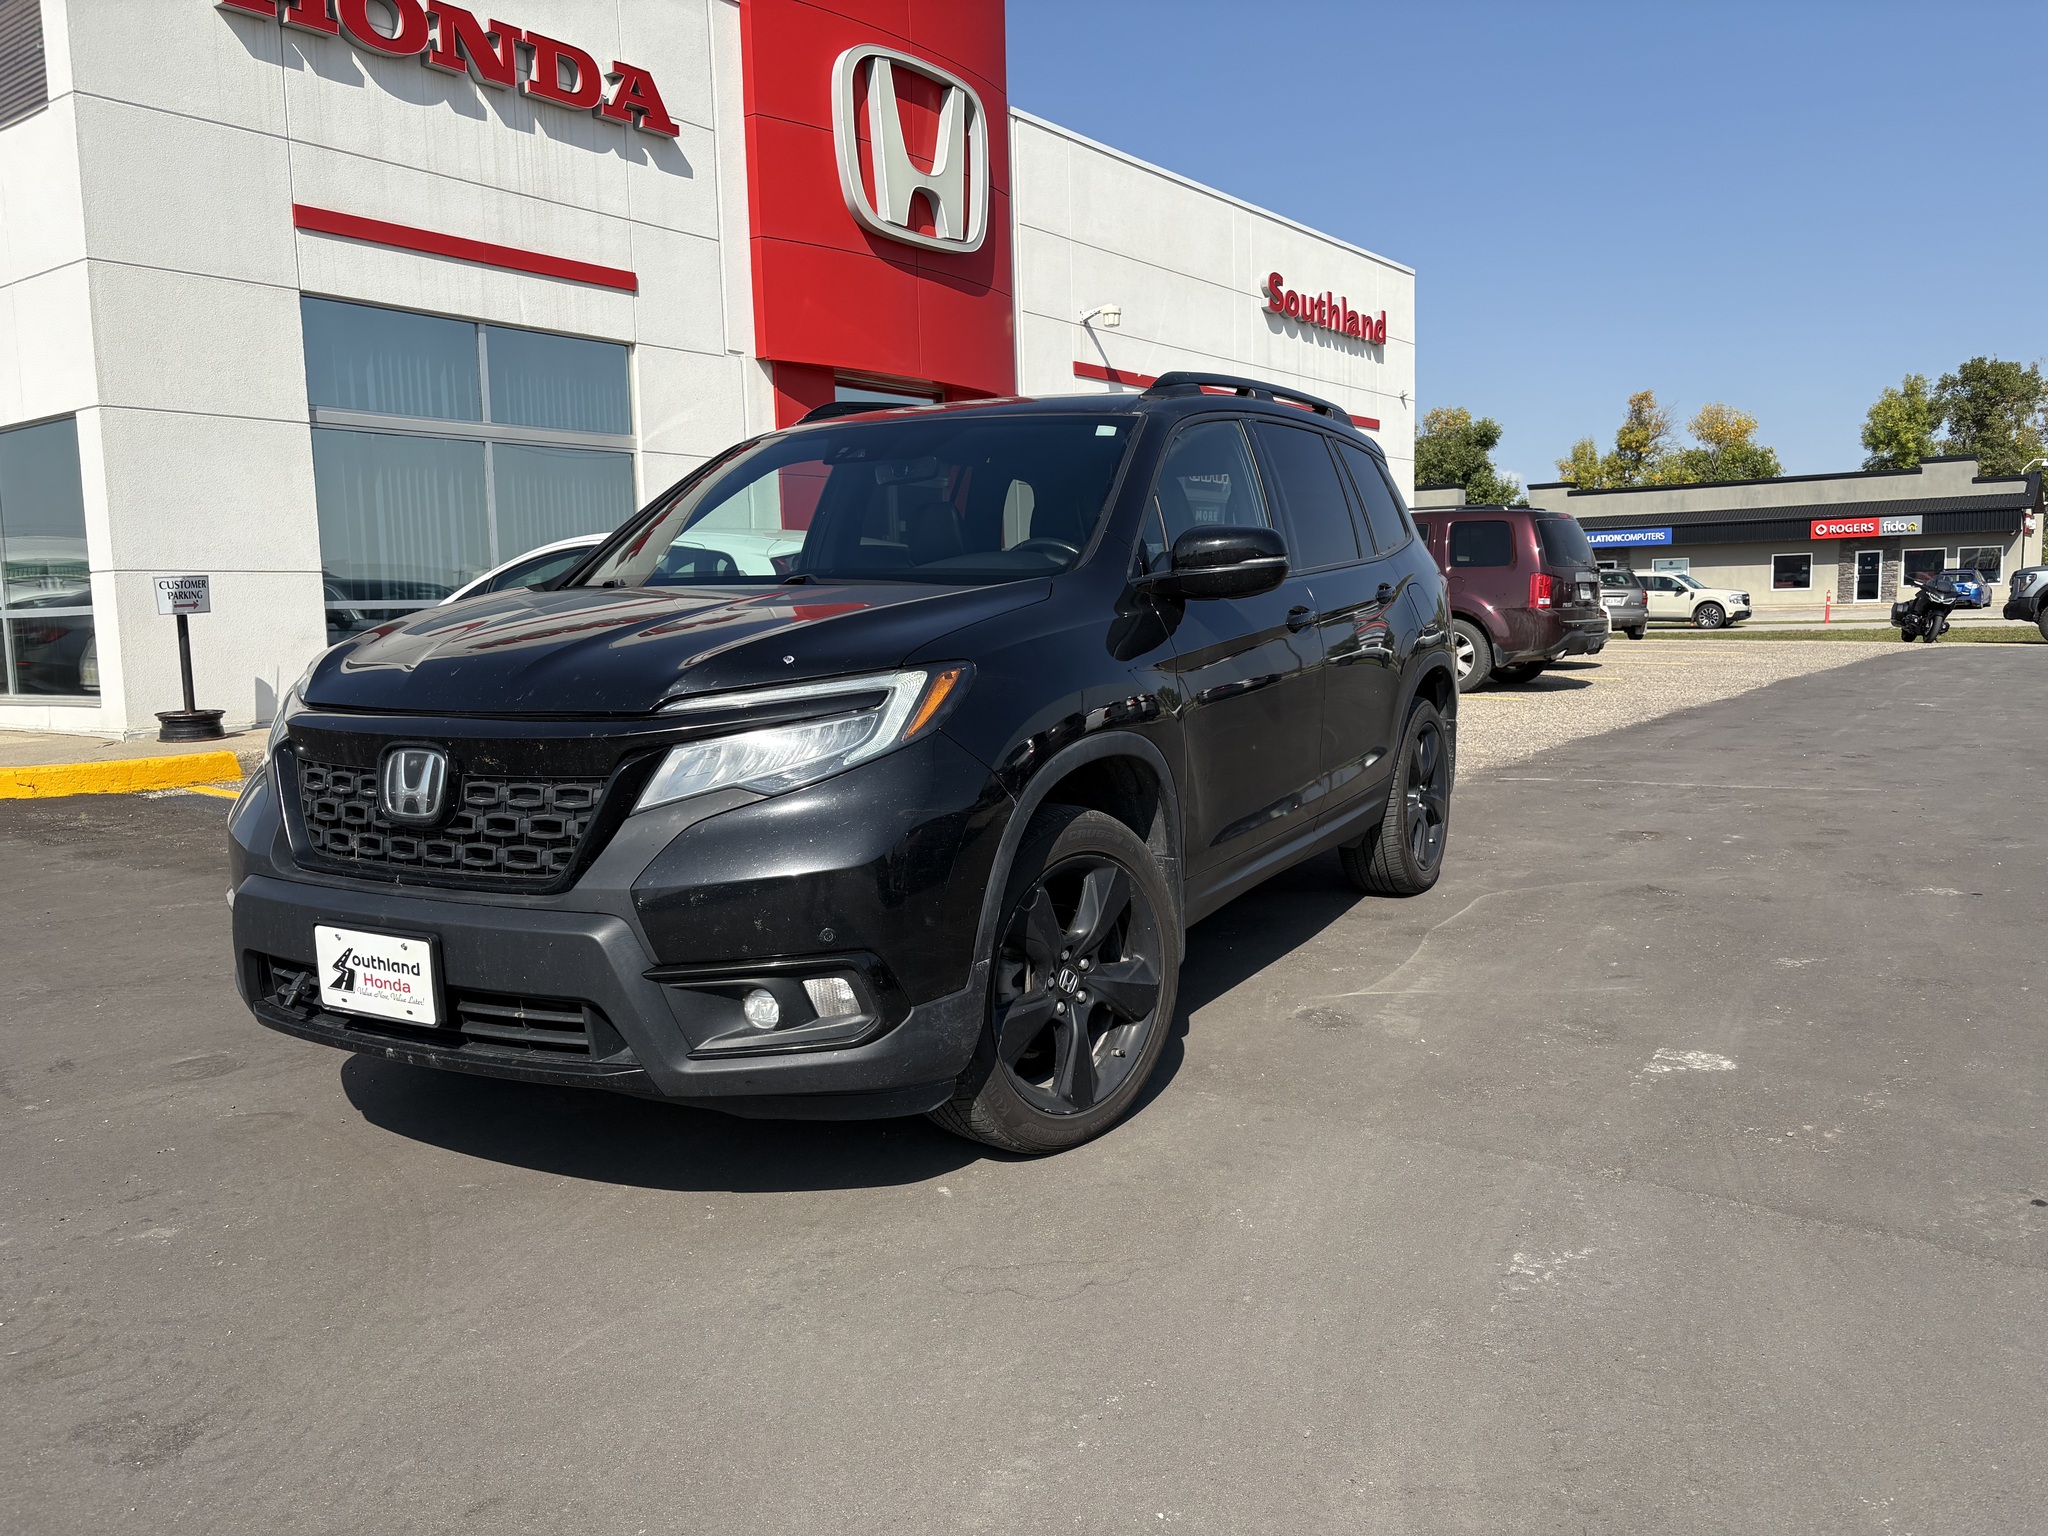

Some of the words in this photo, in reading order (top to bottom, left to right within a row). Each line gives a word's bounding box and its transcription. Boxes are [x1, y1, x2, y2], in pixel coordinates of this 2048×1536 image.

[1262, 271, 1387, 345] Southland
[1829, 522, 1875, 533] ROGERS
[1882, 520, 1907, 532] fido
[158, 579, 207, 590] CUSTOMER
[167, 590, 203, 600] PARKING
[363, 972, 411, 994] Honda
